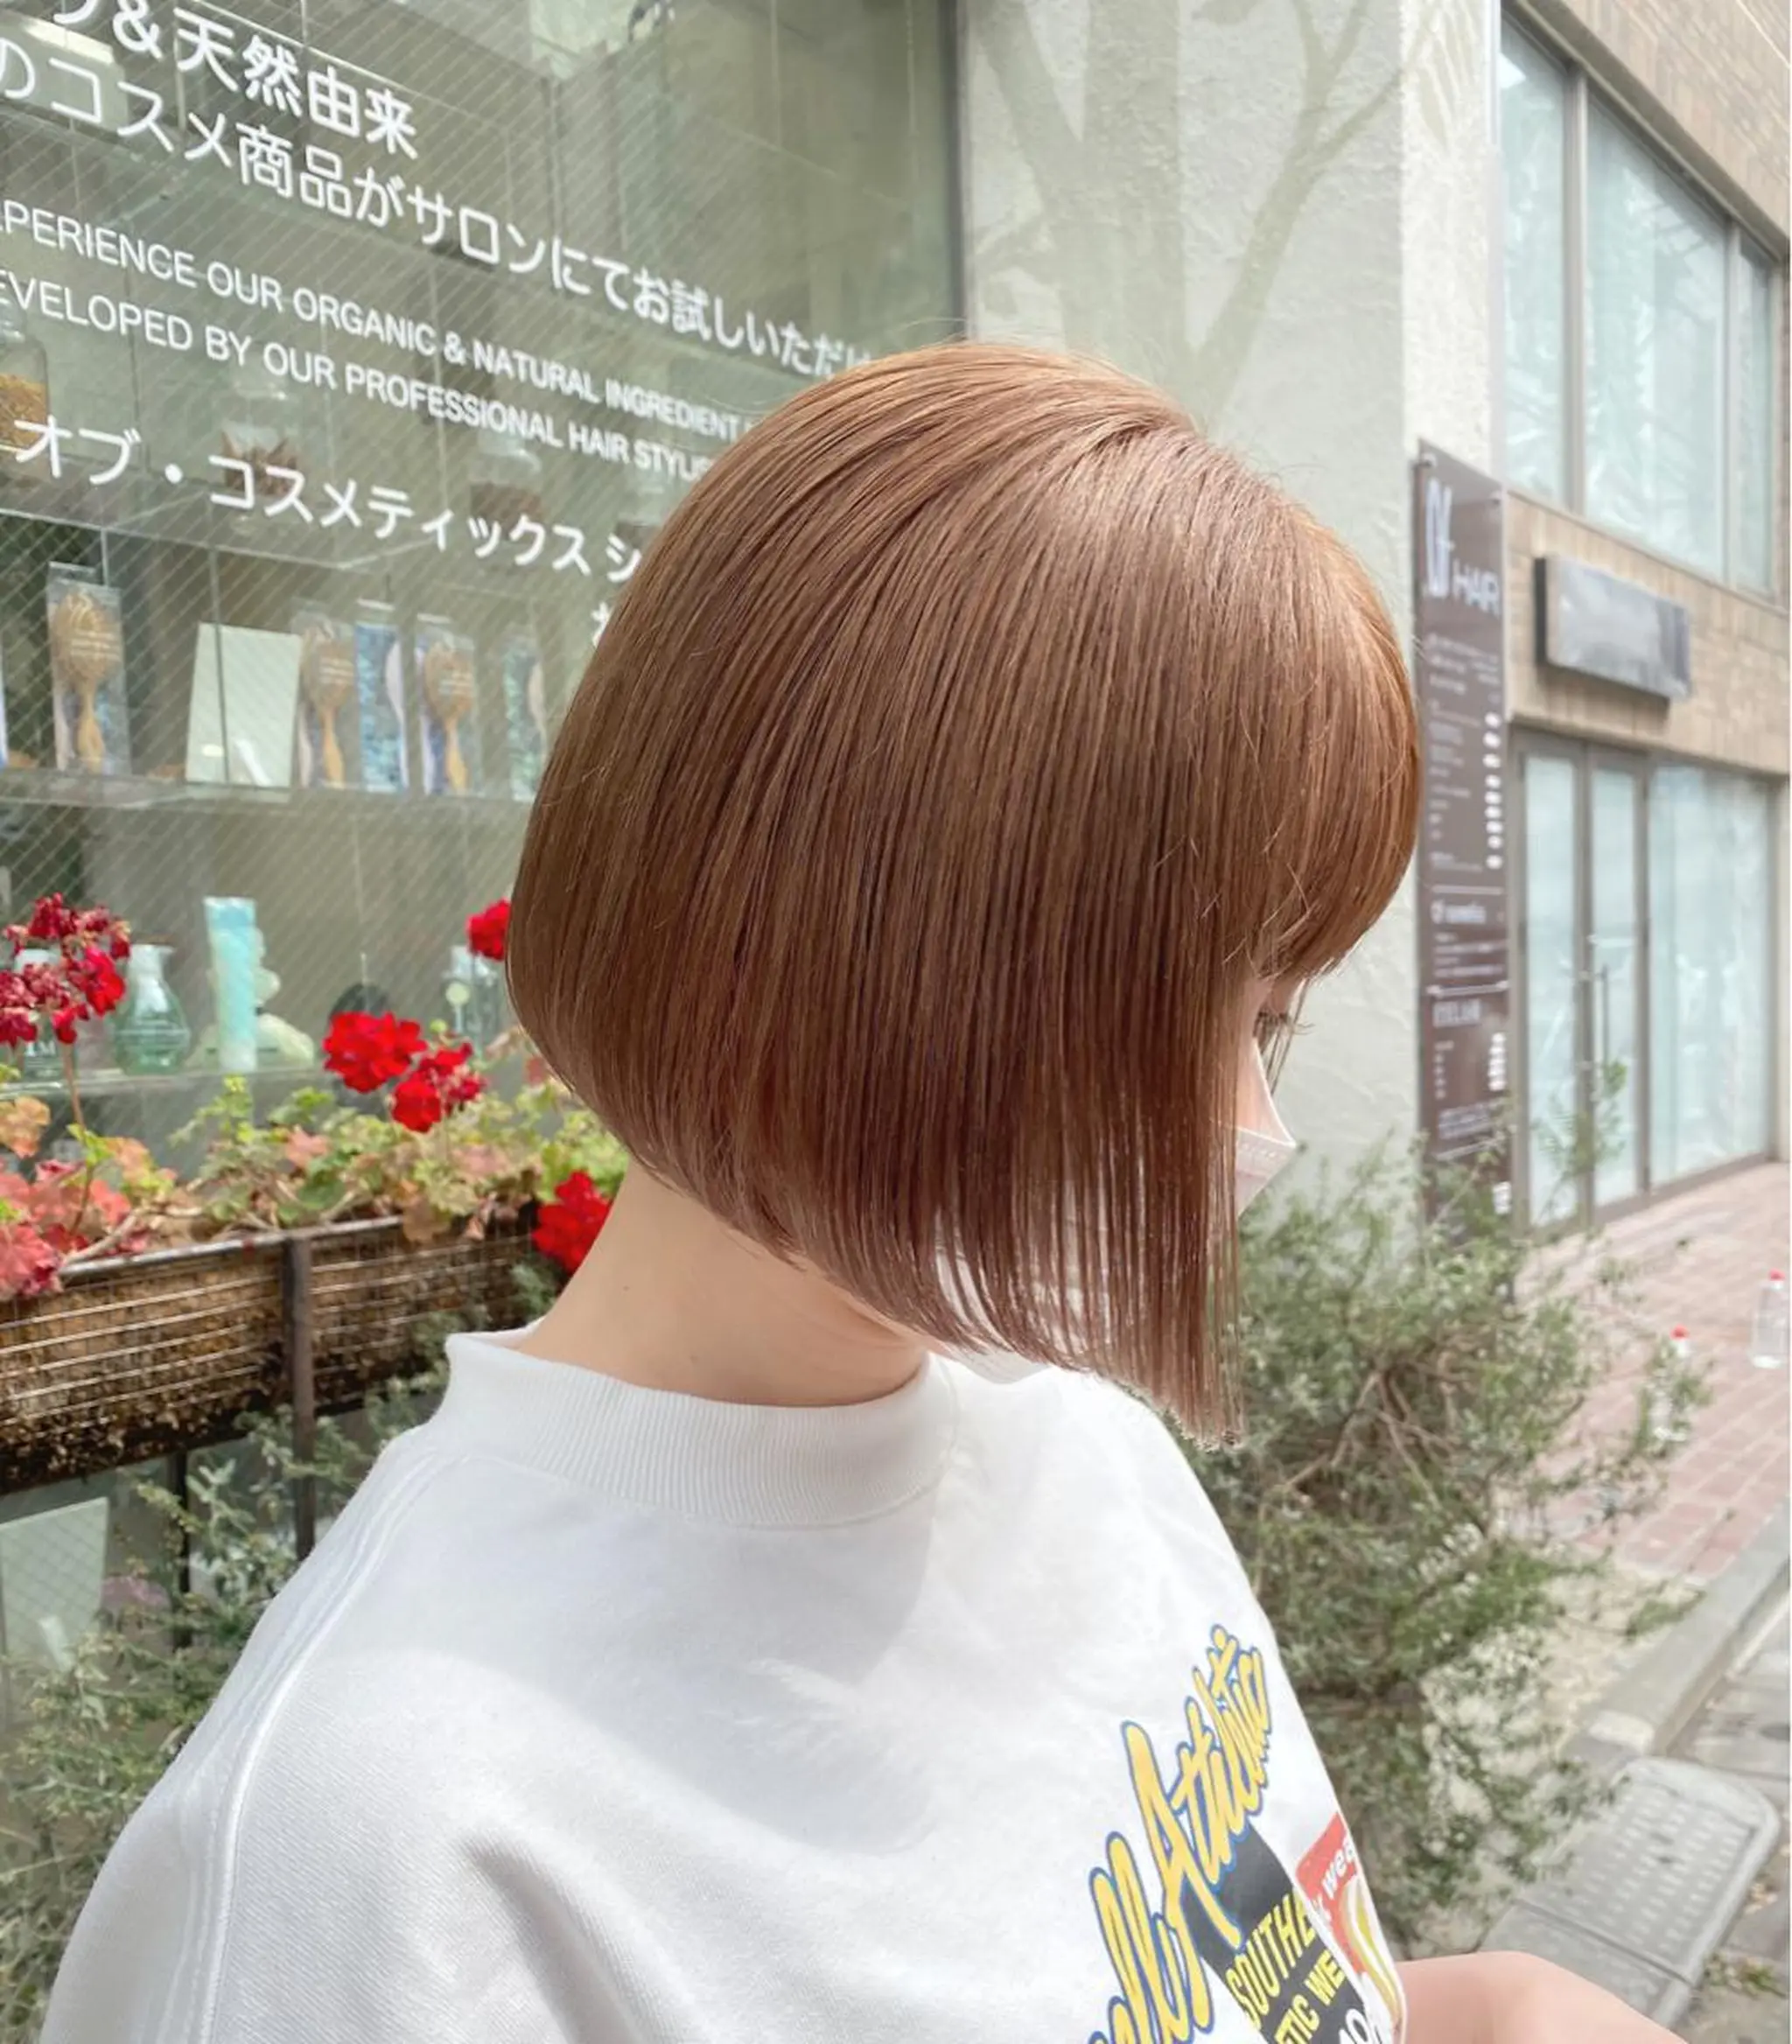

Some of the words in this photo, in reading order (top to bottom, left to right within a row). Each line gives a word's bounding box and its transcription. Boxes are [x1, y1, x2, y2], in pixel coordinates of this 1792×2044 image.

[0, 200, 198, 288] PERIENCE
[206, 262, 284, 313] OUR
[292, 287, 436, 355] ORGANIC
[444, 330, 467, 366] &
[472, 339, 601, 404] NATURAL
[205, 326, 252, 366] BY
[263, 342, 339, 390] OUR
[345, 362, 564, 449] PROFESSIONAL
[568, 420, 631, 466] HAIR
